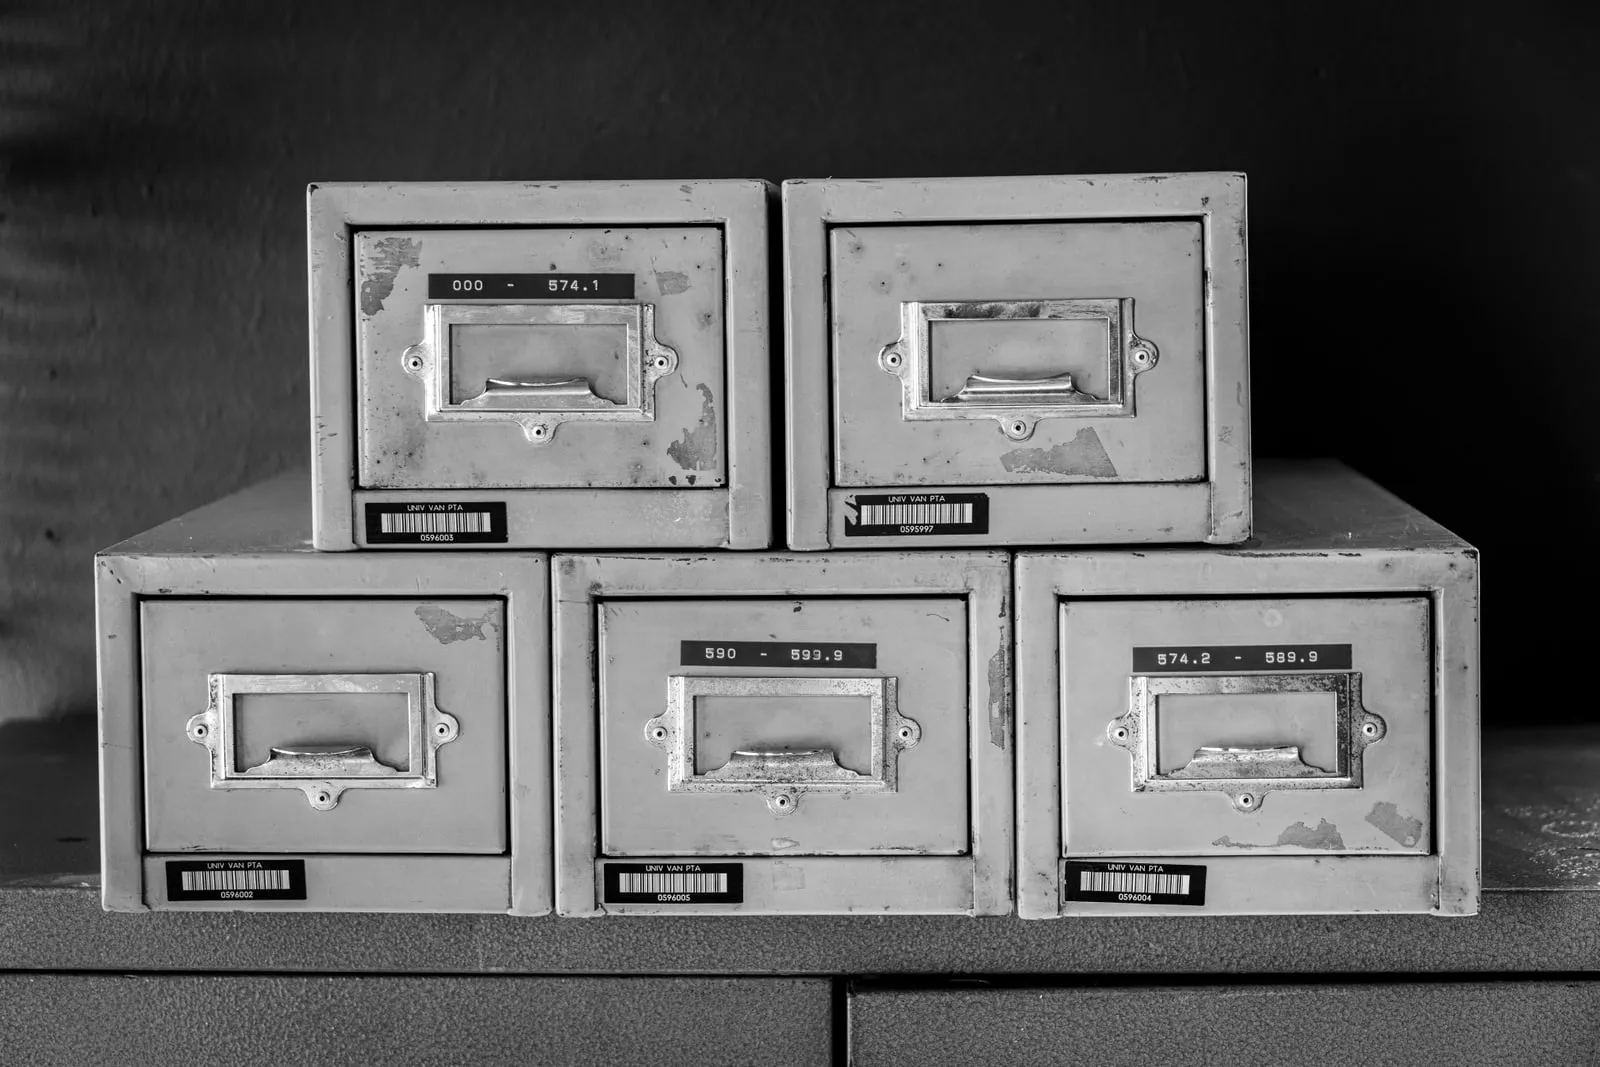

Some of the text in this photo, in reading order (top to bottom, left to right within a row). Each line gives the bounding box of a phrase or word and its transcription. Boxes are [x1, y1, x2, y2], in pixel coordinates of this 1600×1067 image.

[452, 280, 483, 291] 000
[548, 280, 599, 291] 574.1
[900, 525, 934, 533] 0595997
[705, 648, 736, 659] 590
[791, 649, 843, 661] 599.9
[1157, 653, 1211, 665] 574.2
[1265, 651, 1318, 663] 589.9
[1129, 864, 1146, 872] VAN
[1118, 893, 1152, 901] 0596004
